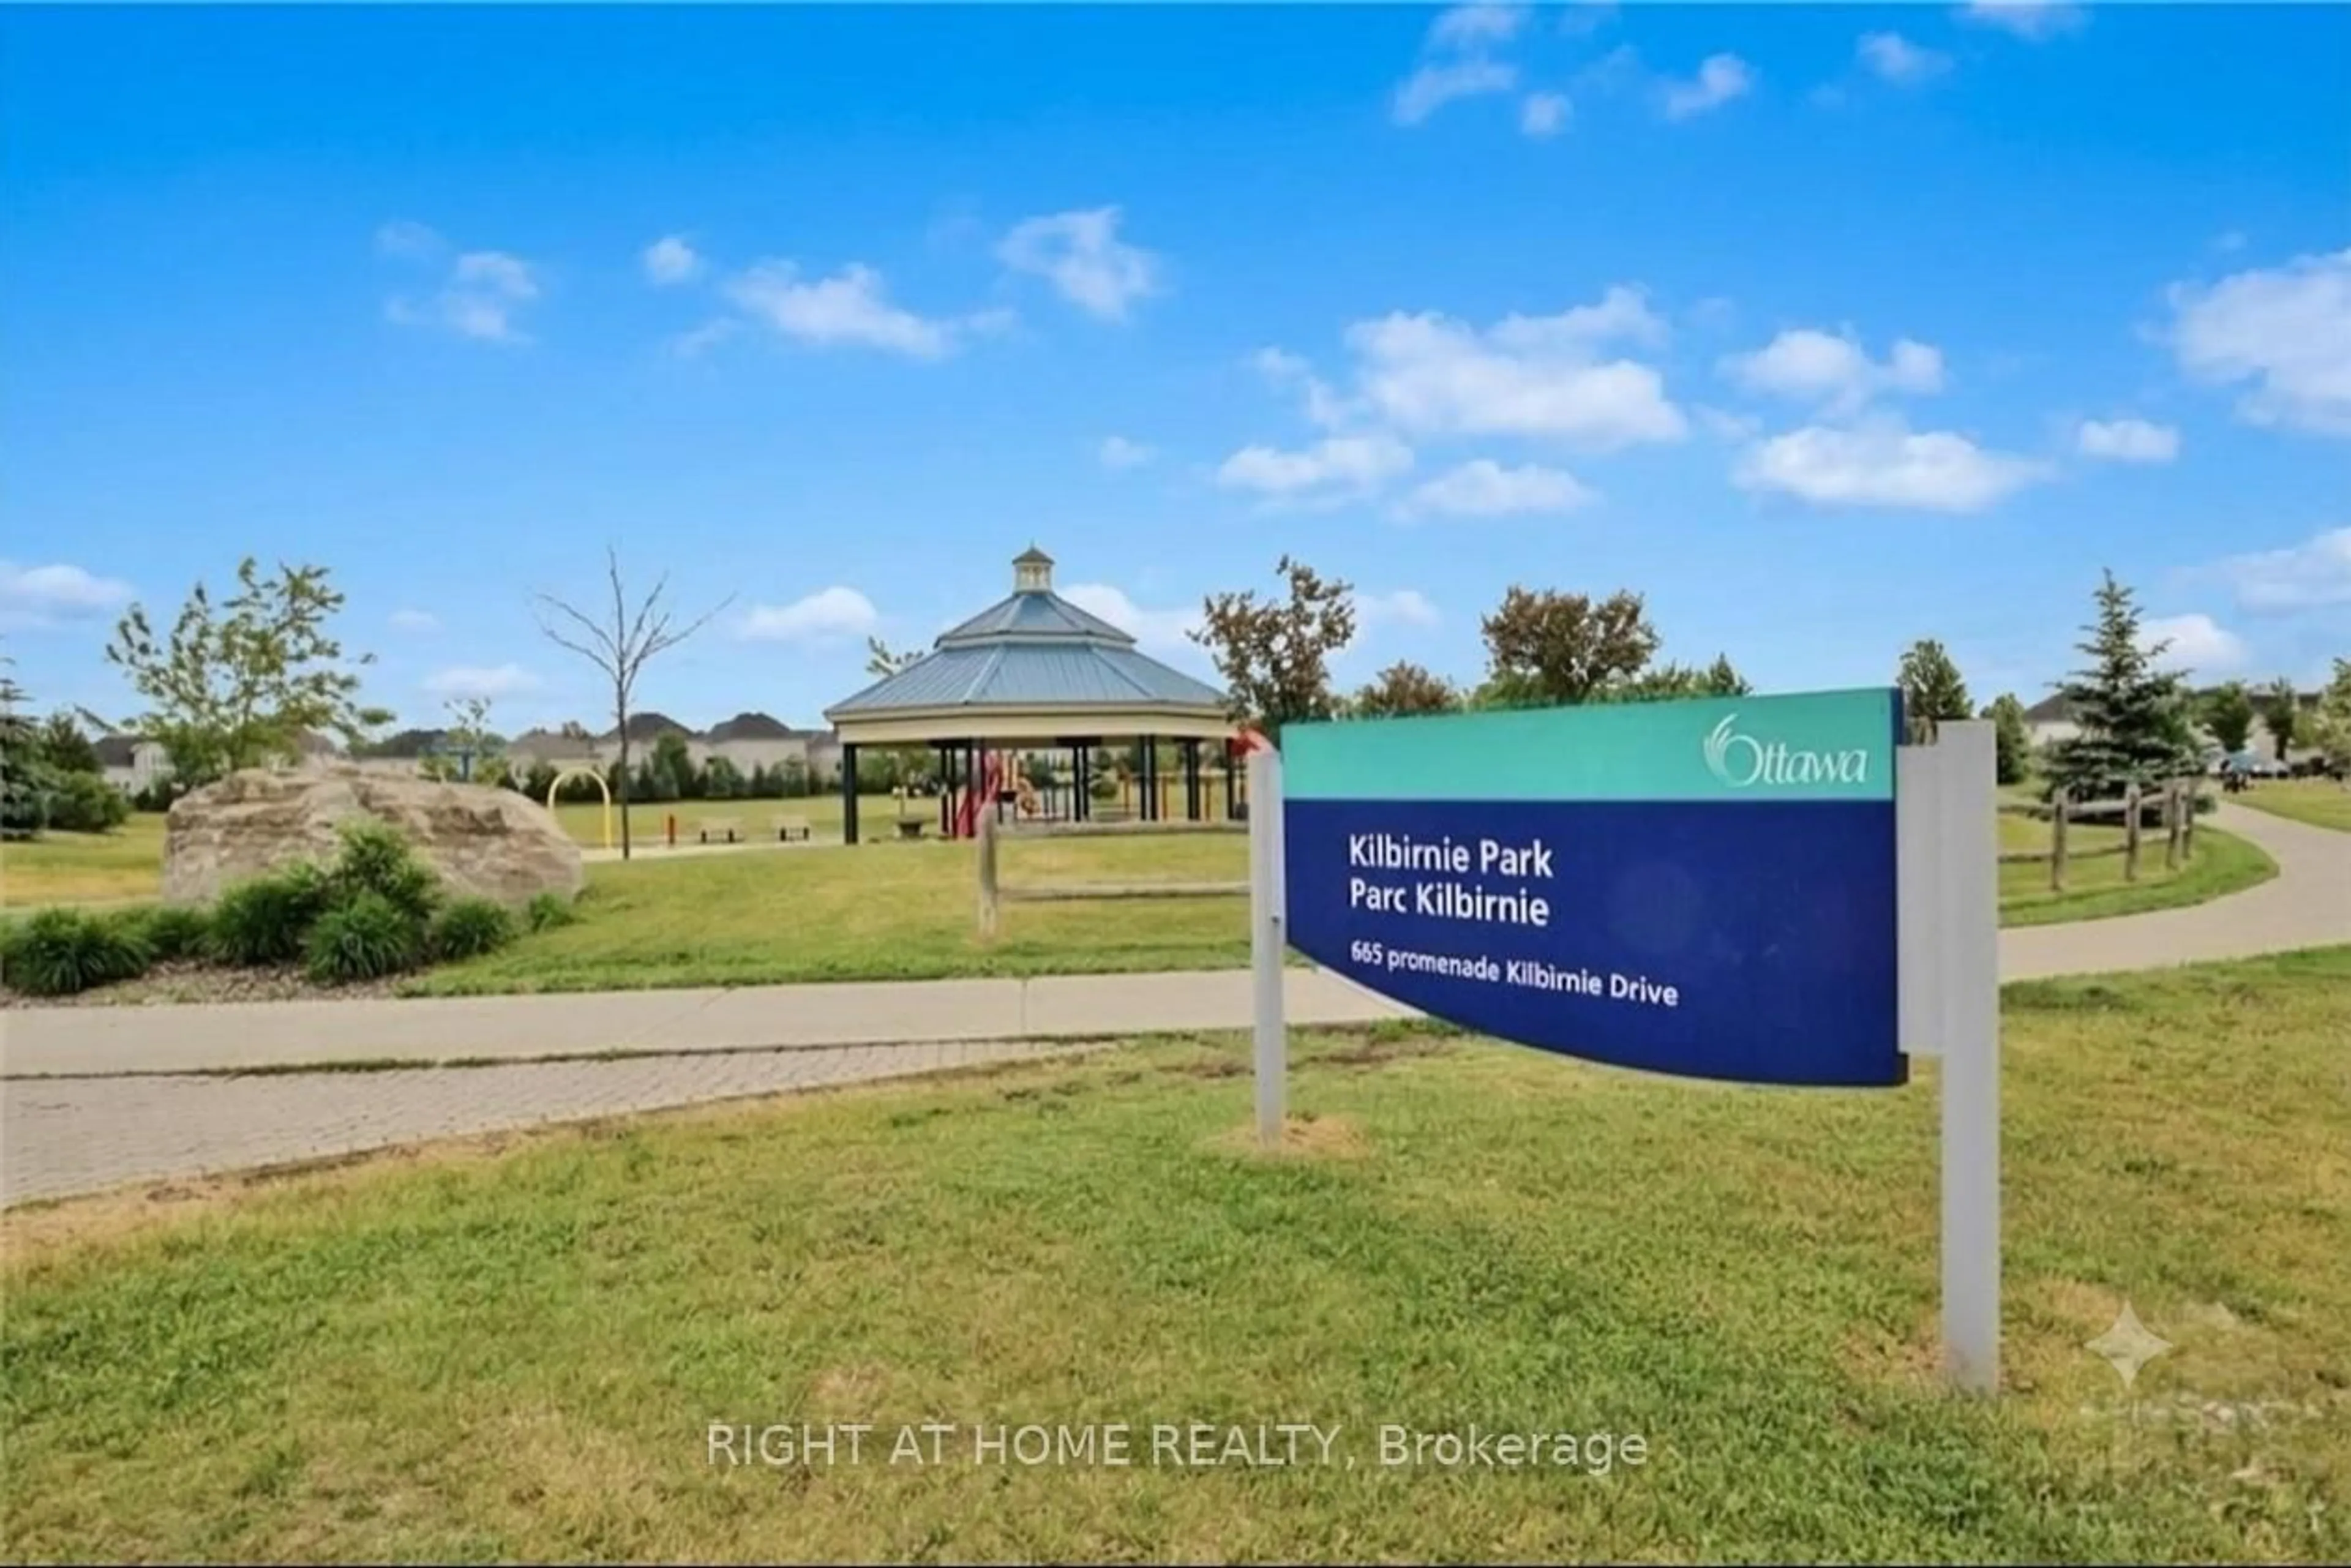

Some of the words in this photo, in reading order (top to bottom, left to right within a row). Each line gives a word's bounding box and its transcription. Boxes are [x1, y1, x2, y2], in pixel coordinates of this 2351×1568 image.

[1704, 713, 1868, 787] Ottawa
[1350, 833, 1470, 872] Kilbirnie
[1480, 839, 1553, 877] Park
[1350, 877, 1407, 913] Parc
[1416, 882, 1550, 926] Kilbirnie
[1351, 940, 1383, 965] 665
[1387, 950, 1500, 981] promenade
[1506, 960, 1603, 996] Kilbirnie
[1610, 973, 1679, 1007] Drive
